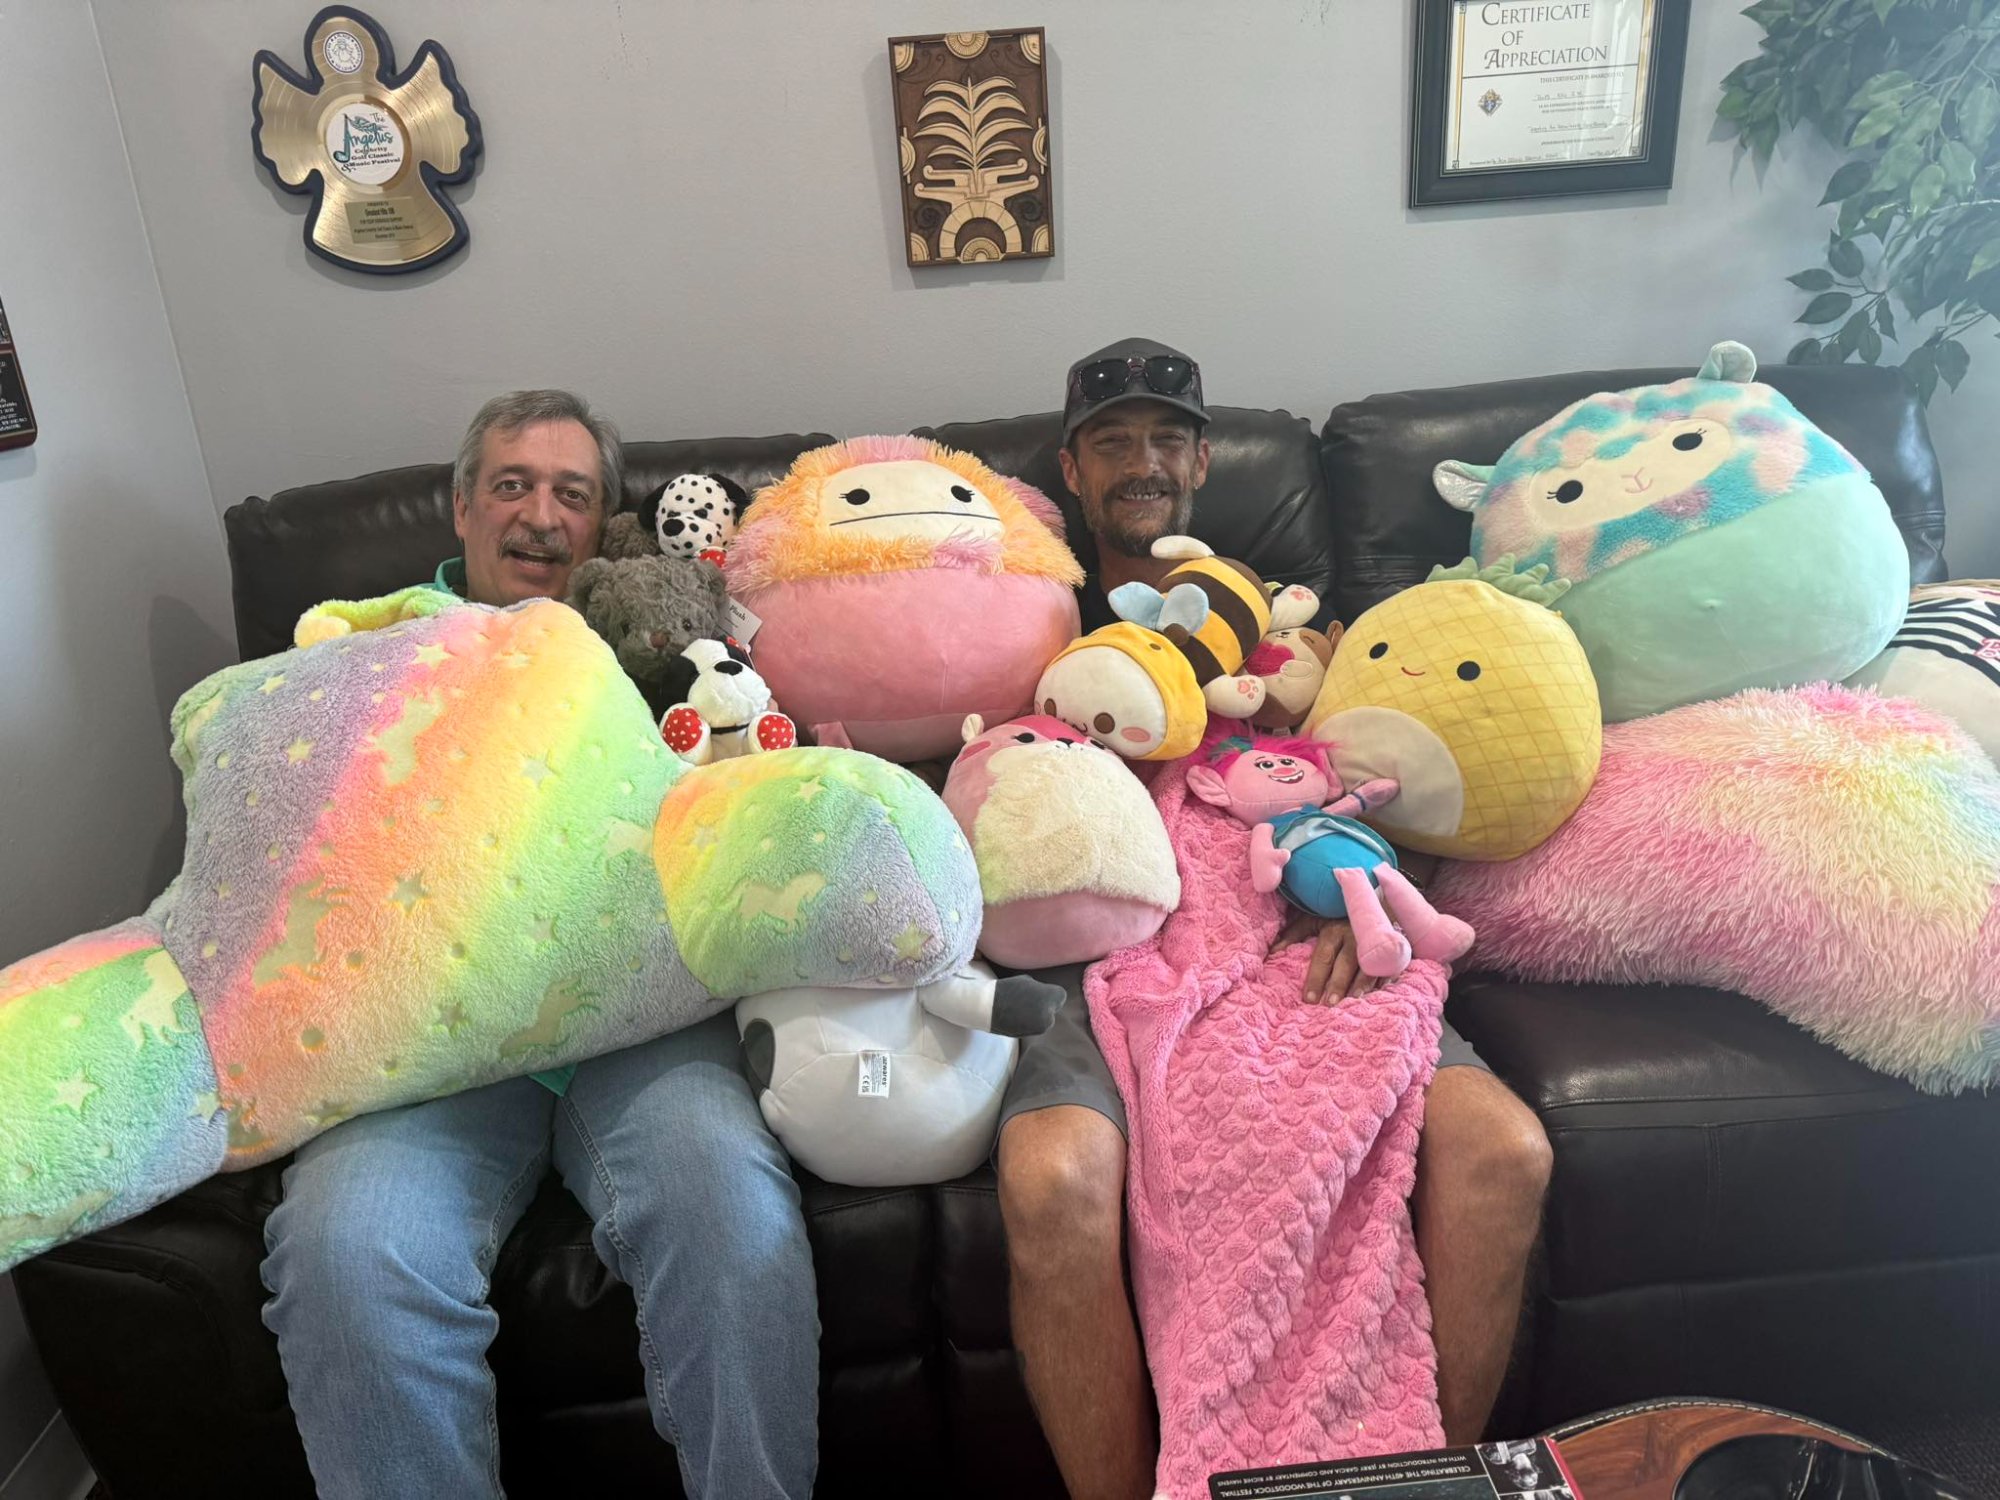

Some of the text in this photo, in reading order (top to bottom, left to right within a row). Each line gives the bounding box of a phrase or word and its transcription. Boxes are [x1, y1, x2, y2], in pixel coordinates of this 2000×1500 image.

[1481, 2, 1591, 26] CERTIFICATE
[1501, 30, 1524, 47] OF
[1484, 46, 1608, 70] APPRECIATION
[370, 112, 386, 122] The
[729, 605, 746, 621] Plush
[1387, 1458, 1436, 1468] INTRODUCTION
[1275, 1470, 1318, 1480] COMMENTARY
[1335, 1466, 1359, 1474] GARCIA
[1420, 1466, 1471, 1476] CELEBRATING
[1334, 1474, 1384, 1486] ANNIVERSARY
[1220, 1488, 1253, 1497] FESTIVAL
[1254, 1482, 1306, 1493] WOODSTOCK
